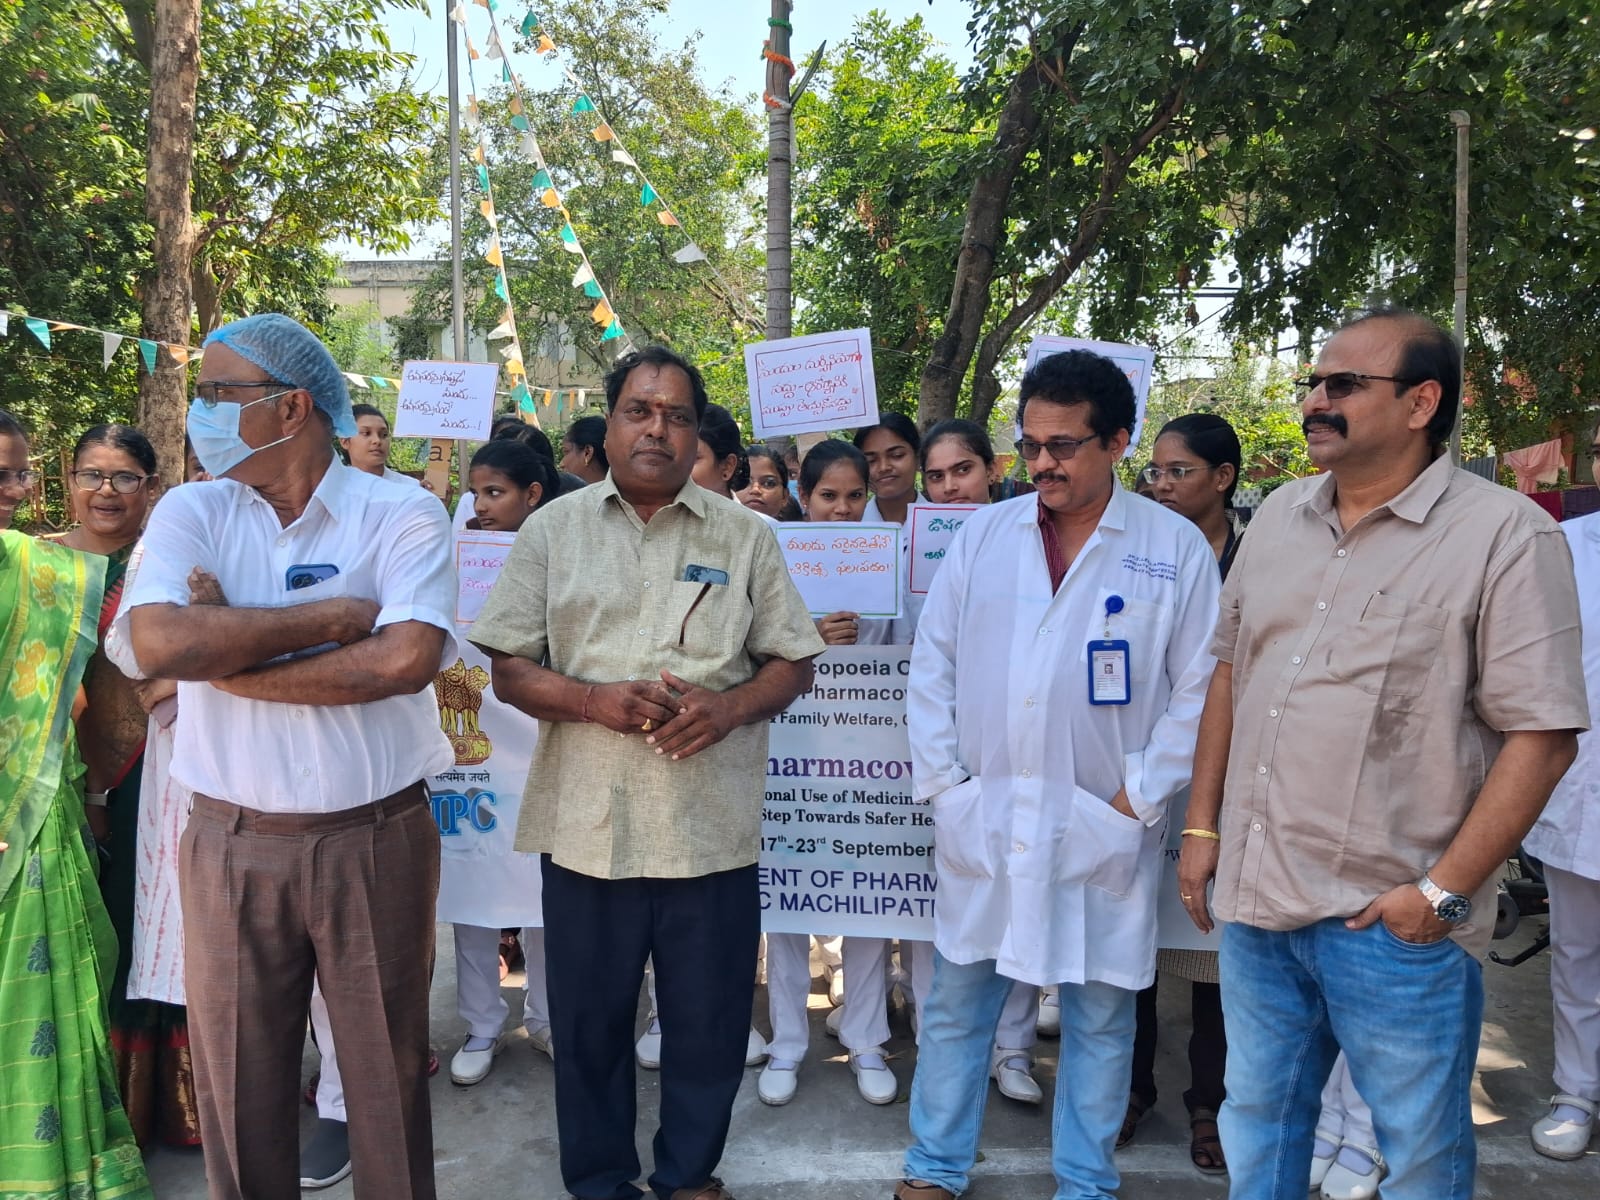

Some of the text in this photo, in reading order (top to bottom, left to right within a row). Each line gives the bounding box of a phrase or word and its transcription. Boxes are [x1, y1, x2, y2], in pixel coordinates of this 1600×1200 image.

[787, 537, 826, 551] మందు
[780, 712, 830, 726] Family
[833, 712, 898, 728] Welfare,
[435, 769, 491, 783] सत्यमेव जयते
[764, 789, 796, 802] onal
[801, 789, 828, 803] Use
[832, 790, 849, 803] of
[430, 791, 498, 836] IPC
[762, 808, 792, 824] Step
[795, 809, 860, 824] Towards
[865, 812, 907, 826] Safer
[832, 839, 935, 858] September
[810, 869, 845, 889] OF
[853, 871, 938, 892] PHARM
